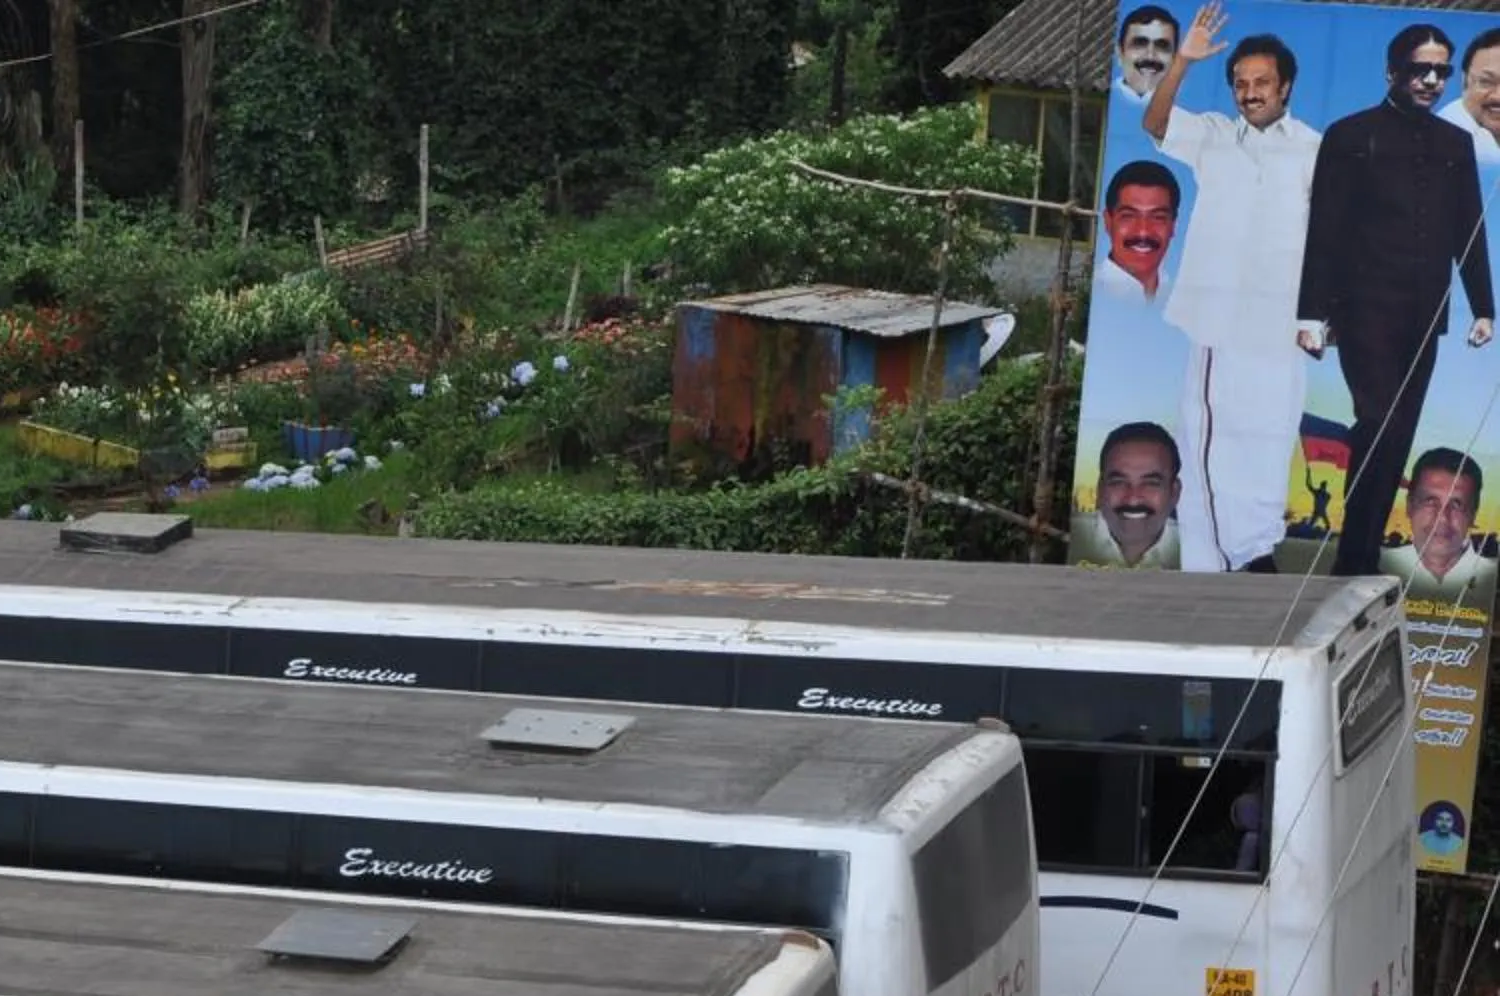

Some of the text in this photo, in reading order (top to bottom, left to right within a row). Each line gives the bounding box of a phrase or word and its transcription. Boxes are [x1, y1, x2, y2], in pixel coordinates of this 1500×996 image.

[283, 657, 418, 685] Executive
[797, 686, 943, 716] Executive
[339, 846, 493, 883] Executive
